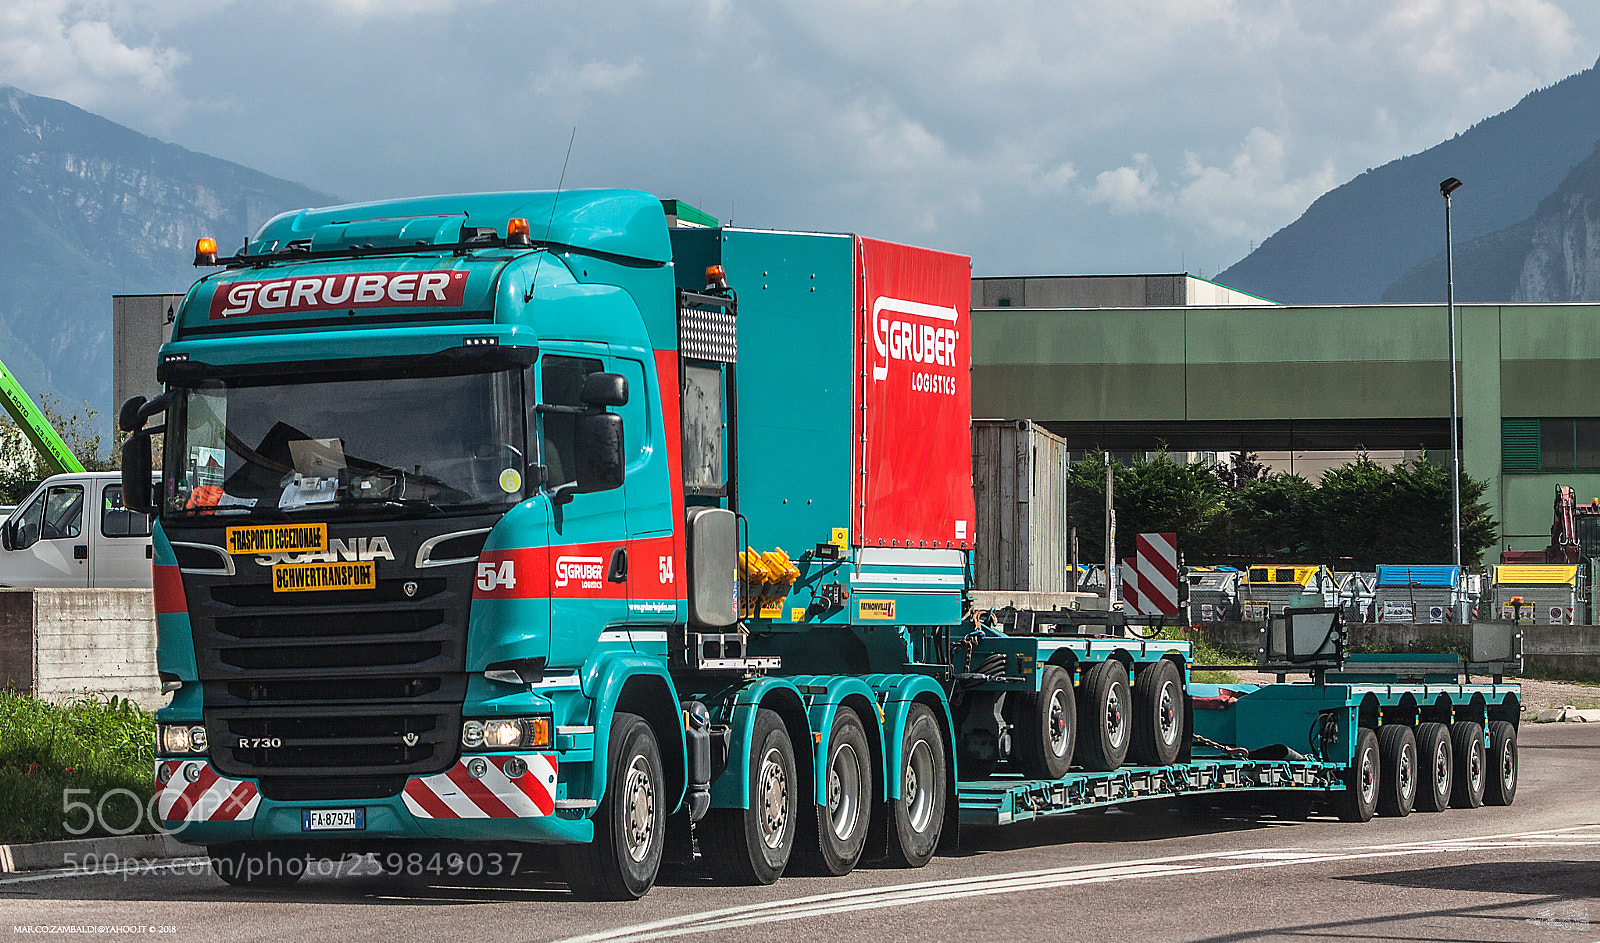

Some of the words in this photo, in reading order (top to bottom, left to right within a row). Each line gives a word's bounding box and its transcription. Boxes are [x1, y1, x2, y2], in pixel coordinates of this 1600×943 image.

[911, 371, 956, 396] LOGISTICS
[12, 395, 29, 418] ROTO
[230, 528, 274, 550] TRASPORTO
[275, 527, 321, 549] ECCEZIONALE
[275, 565, 371, 588] SCHWERTRANSPORT
[477, 560, 517, 591] 54
[658, 555, 674, 584] 54
[860, 602, 888, 611] FAYMONVILLE
